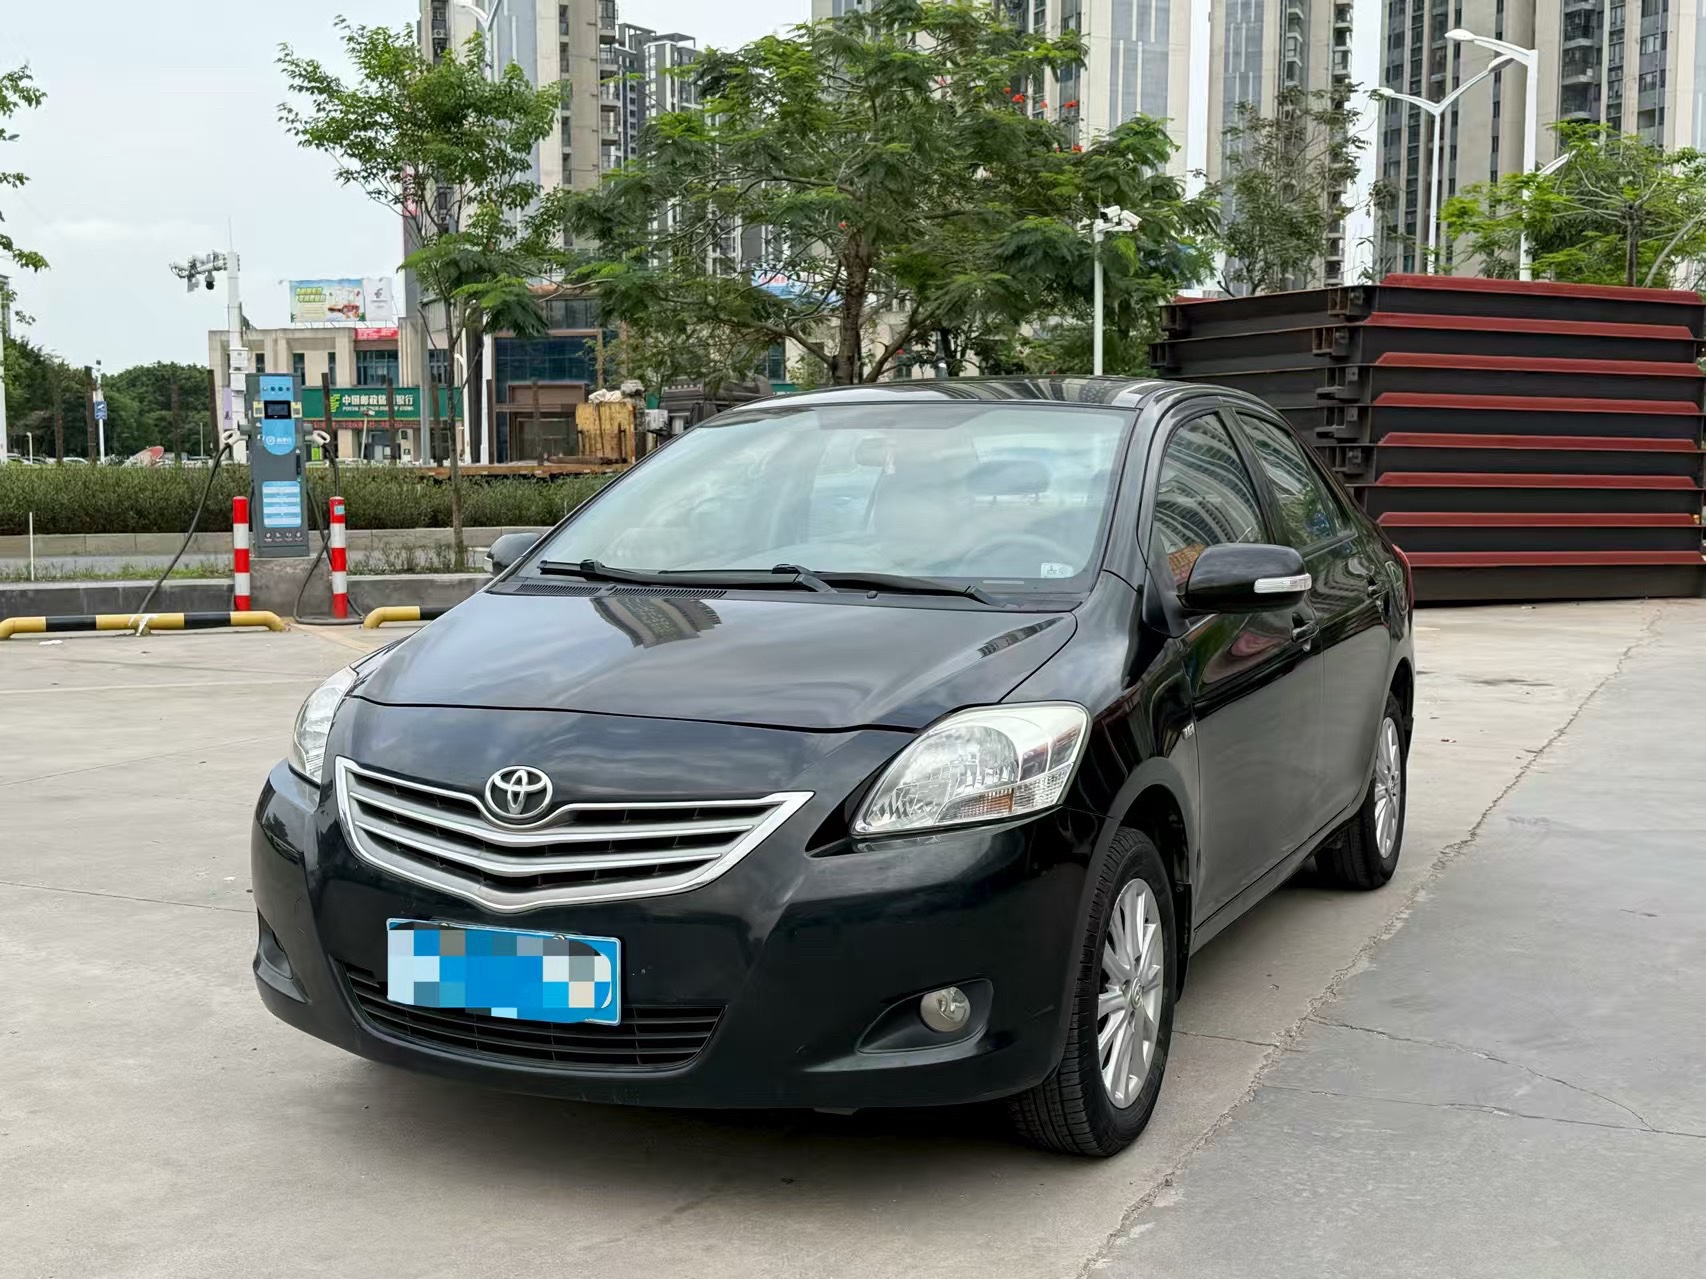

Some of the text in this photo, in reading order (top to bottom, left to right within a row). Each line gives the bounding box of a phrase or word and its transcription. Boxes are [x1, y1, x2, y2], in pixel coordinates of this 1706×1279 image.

[342, 394, 413, 405] 中国邮政储银行
